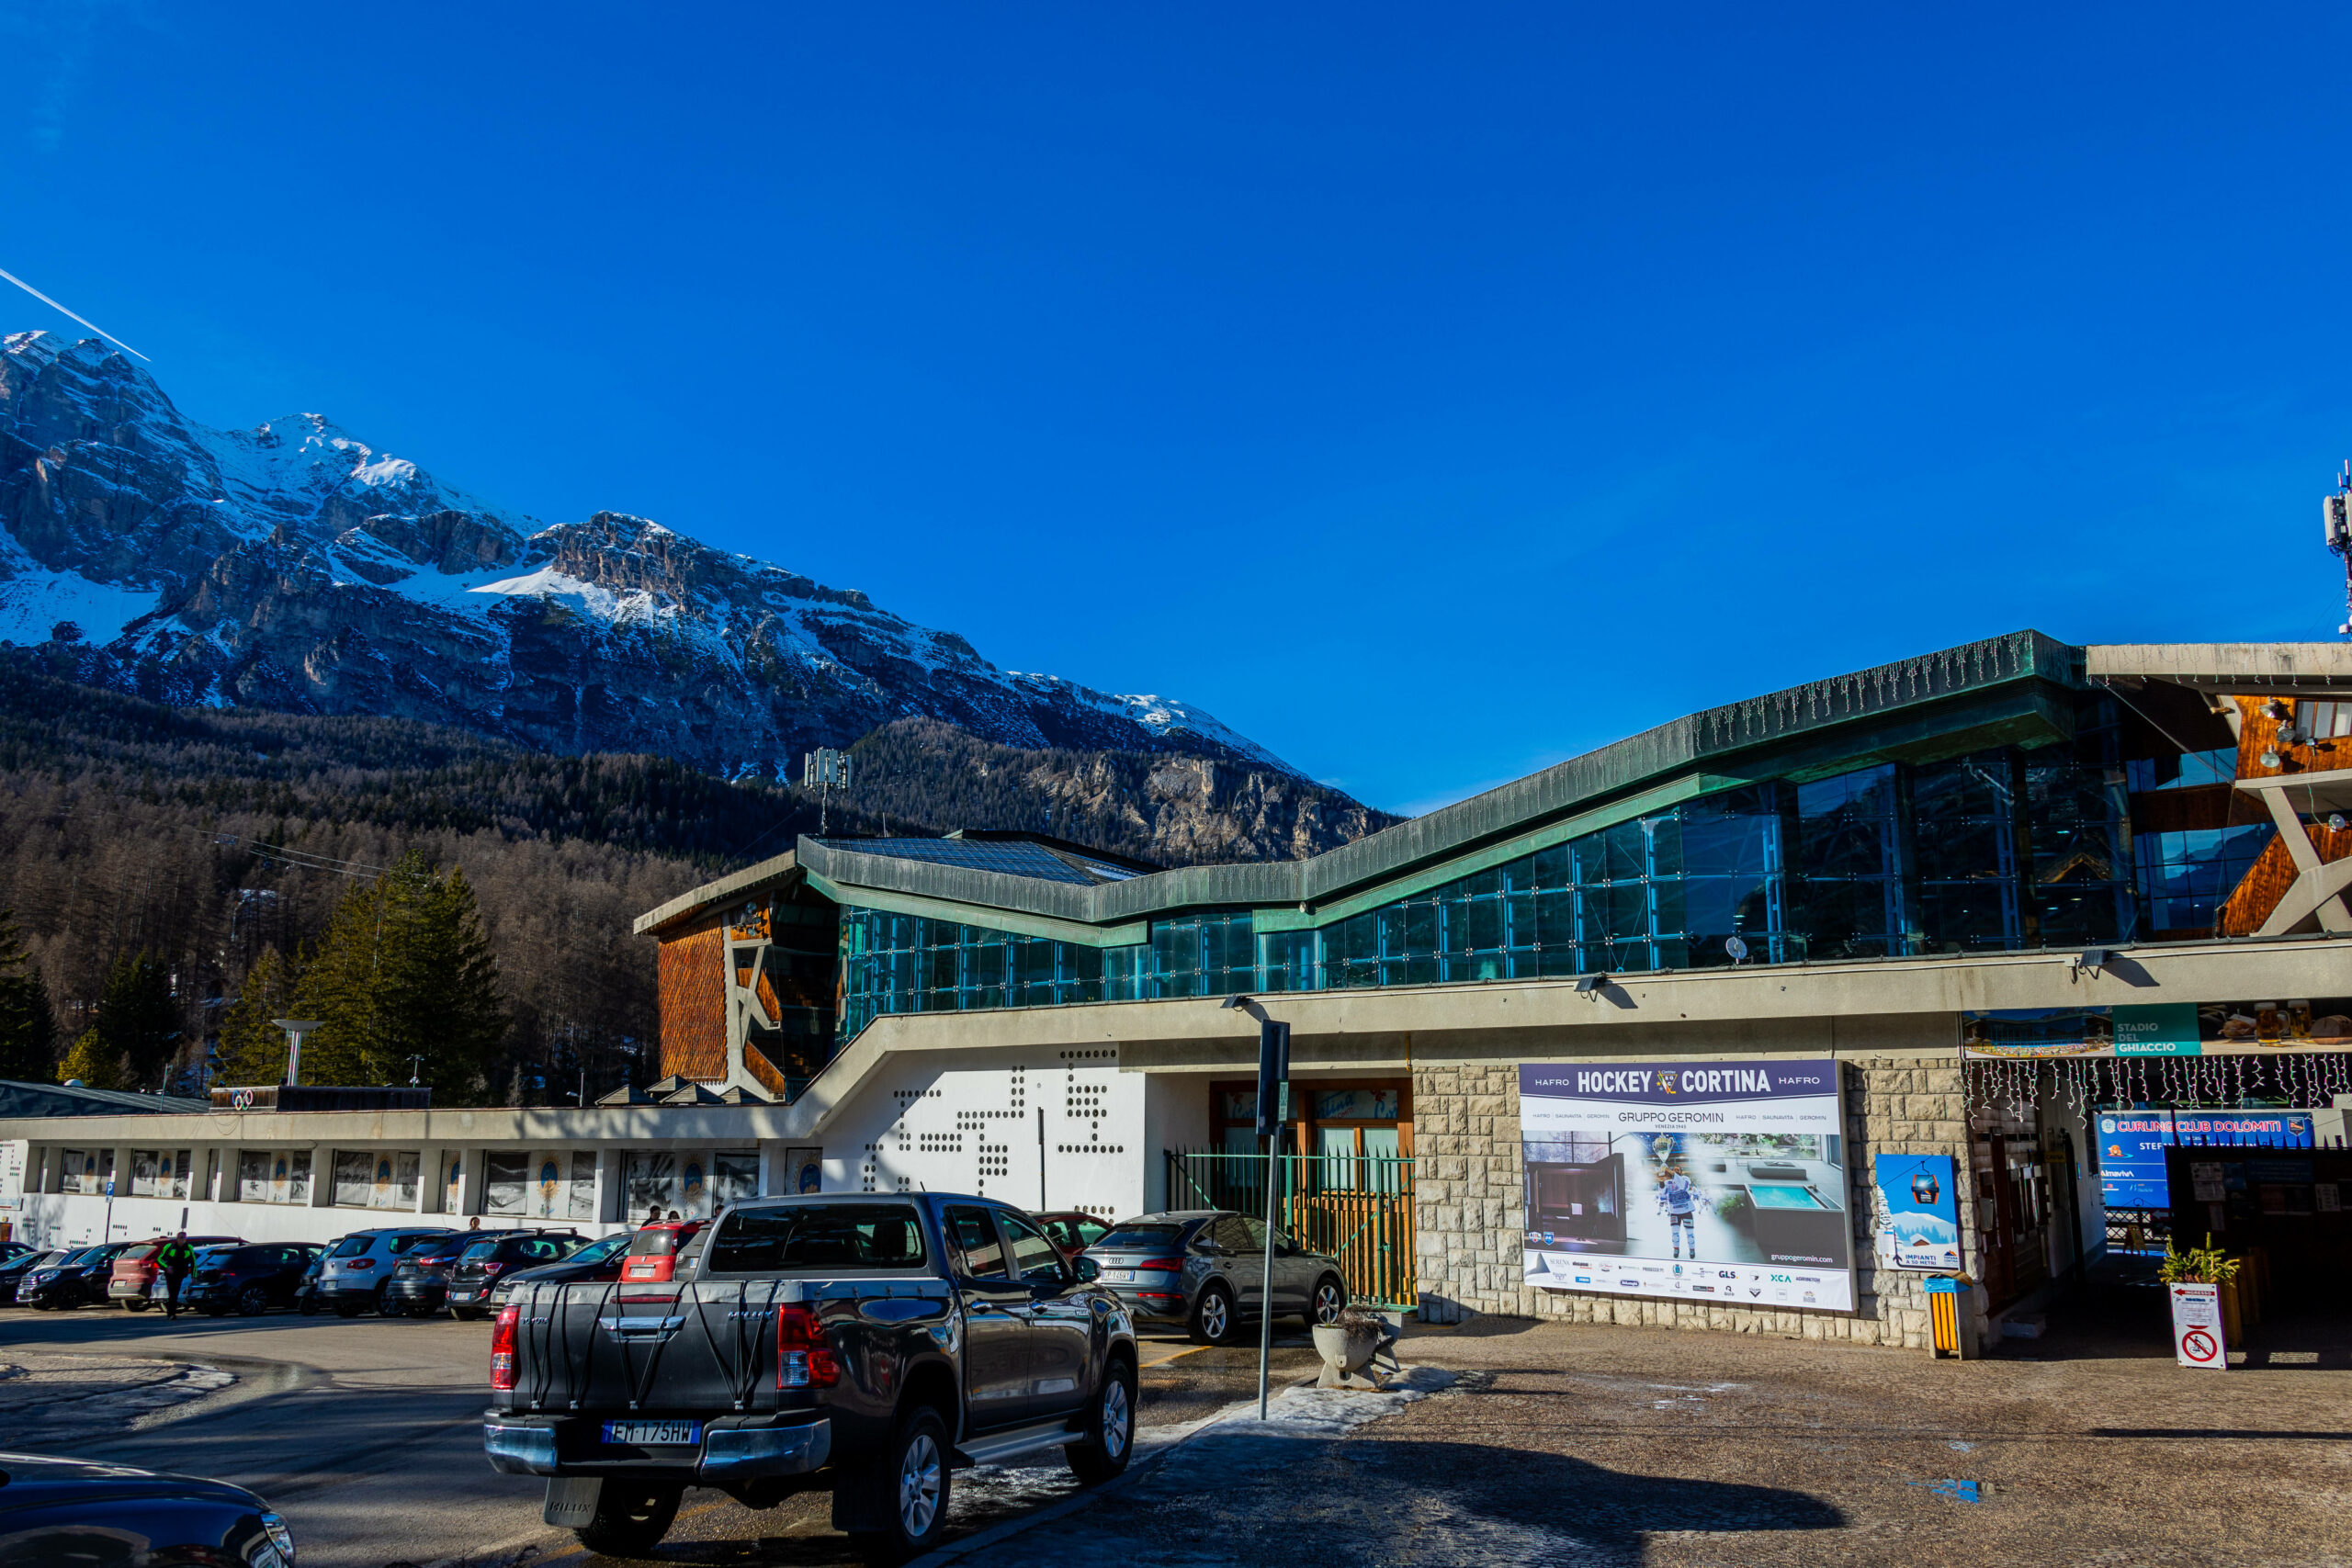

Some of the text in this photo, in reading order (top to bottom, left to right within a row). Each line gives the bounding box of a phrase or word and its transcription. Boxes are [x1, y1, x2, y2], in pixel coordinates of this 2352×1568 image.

[2118, 1022, 2158, 1032] STADIO
[2118, 1033, 2139, 1042] DEL
[2118, 1043, 2177, 1052] GHIACCIO
[1577, 1070, 1653, 1093] HOCKEY
[1681, 1069, 1771, 1093] CORTINA
[1778, 1077, 1820, 1085] HAFRO
[1618, 1111, 1666, 1122] GRUPPO
[1668, 1112, 1724, 1123] GEROMIN
[2117, 1120, 2281, 1133] CURLING CLUB DOLOMITI
[107, 1183, 113, 1194] P
[1771, 1255, 1833, 1263] gruppogeromin.com
[550, 1501, 591, 1513] HILUX
